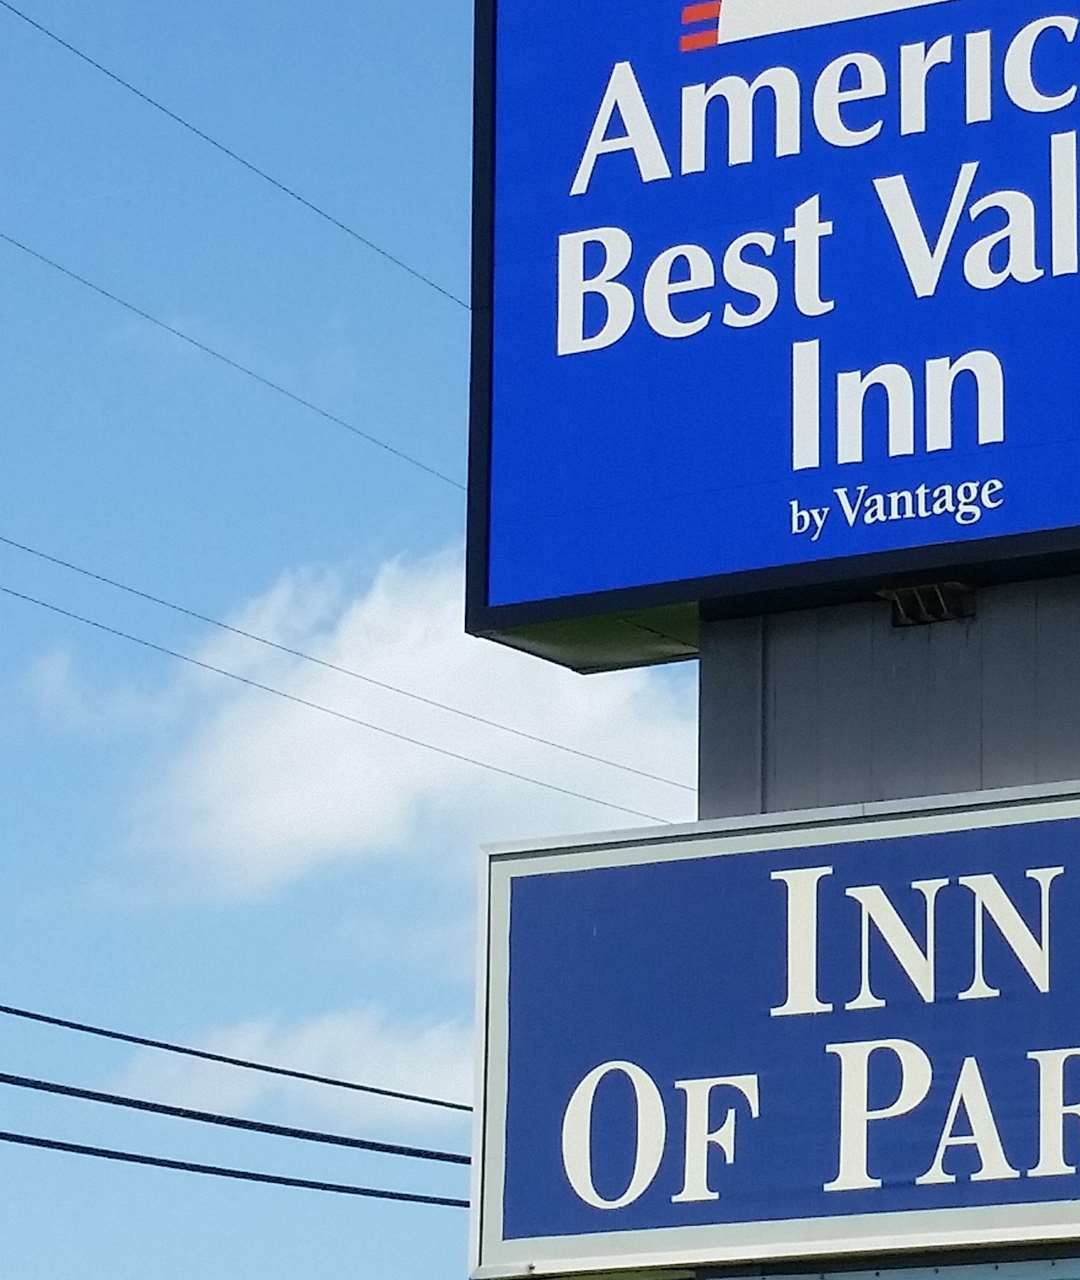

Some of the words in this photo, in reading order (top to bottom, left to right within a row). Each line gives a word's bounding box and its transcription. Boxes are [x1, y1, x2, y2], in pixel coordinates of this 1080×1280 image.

[556, 192, 836, 357] Best
[791, 337, 1005, 472] Inn
[788, 499, 831, 542] by
[832, 478, 1004, 526] Vantage
[769, 865, 1066, 1018] INN
[560, 1059, 760, 1211] OF
